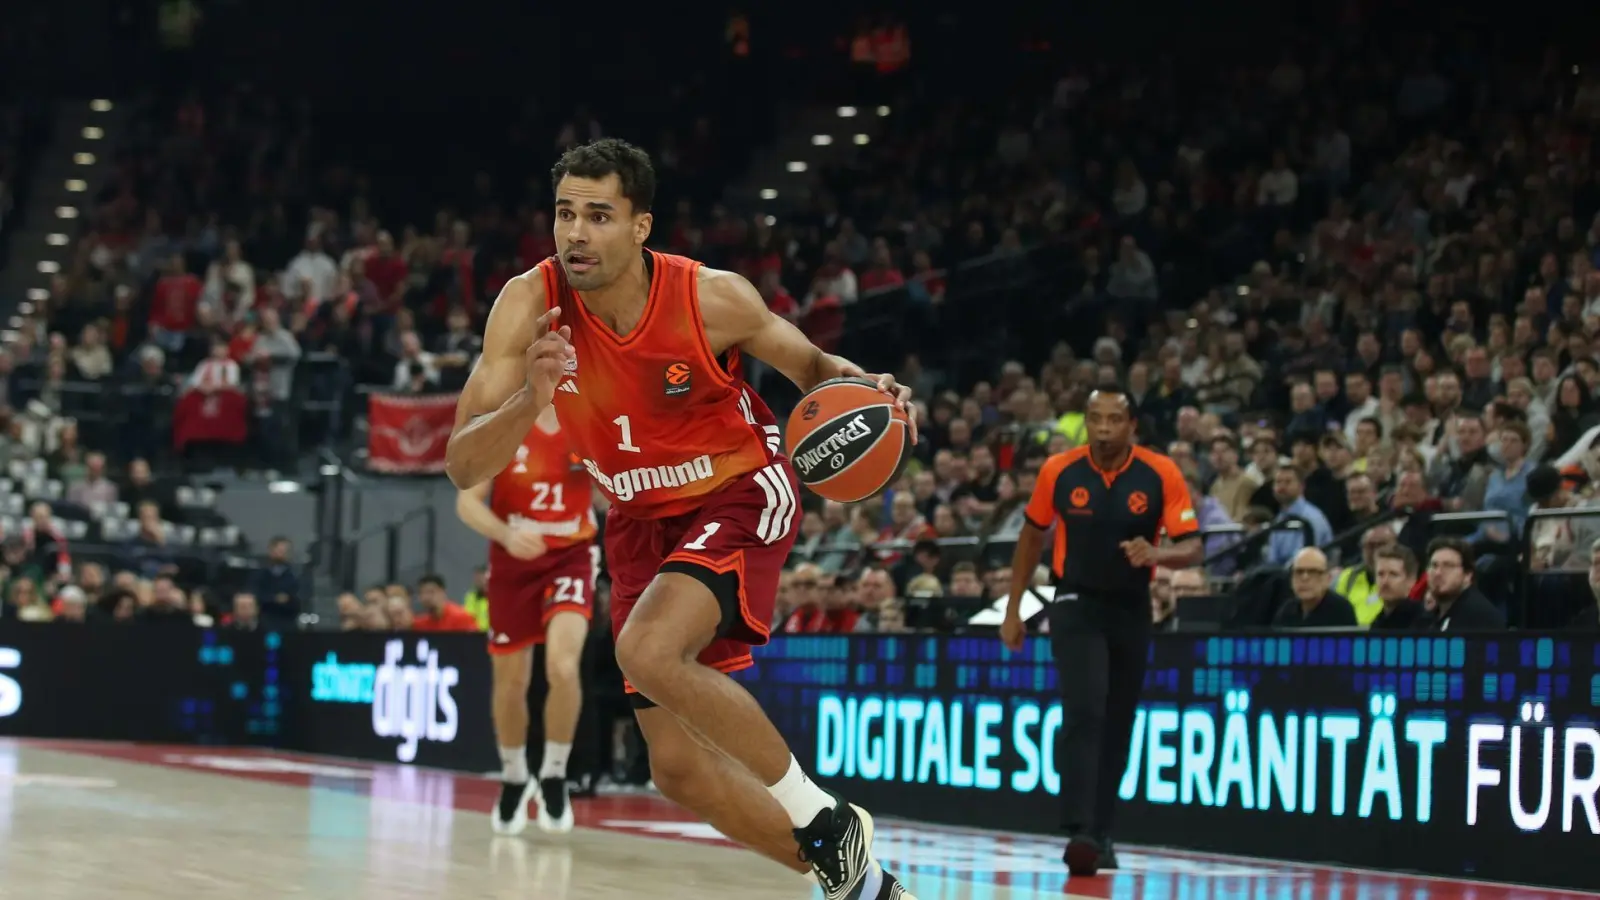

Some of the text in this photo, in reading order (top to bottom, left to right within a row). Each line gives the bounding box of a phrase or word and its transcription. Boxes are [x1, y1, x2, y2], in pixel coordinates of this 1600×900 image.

[612, 415, 641, 453] 1
[794, 413, 872, 475] SPALDING
[530, 482, 566, 511] 21
[683, 522, 721, 550] 1
[554, 576, 586, 604] 21
[373, 638, 459, 762] digits
[816, 689, 1600, 835] DIGITALE SOVERÄNITÄT FÜR
